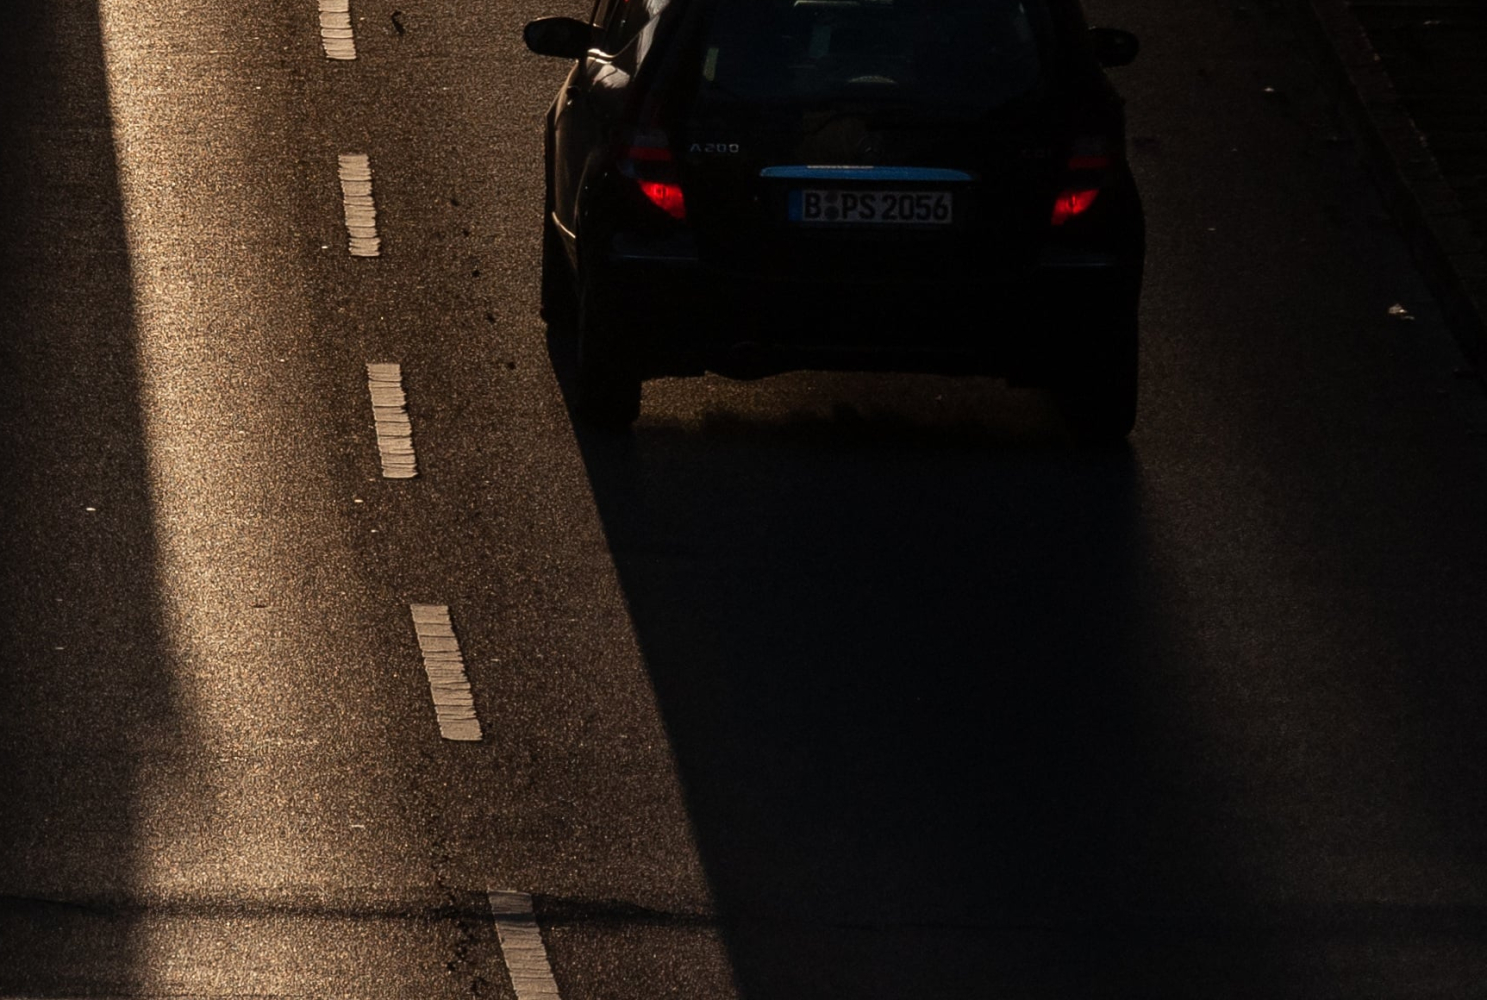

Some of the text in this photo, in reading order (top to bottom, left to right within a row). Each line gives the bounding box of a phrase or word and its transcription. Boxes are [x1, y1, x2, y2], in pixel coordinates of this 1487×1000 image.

[805, 192, 949, 220] B PS 2056
